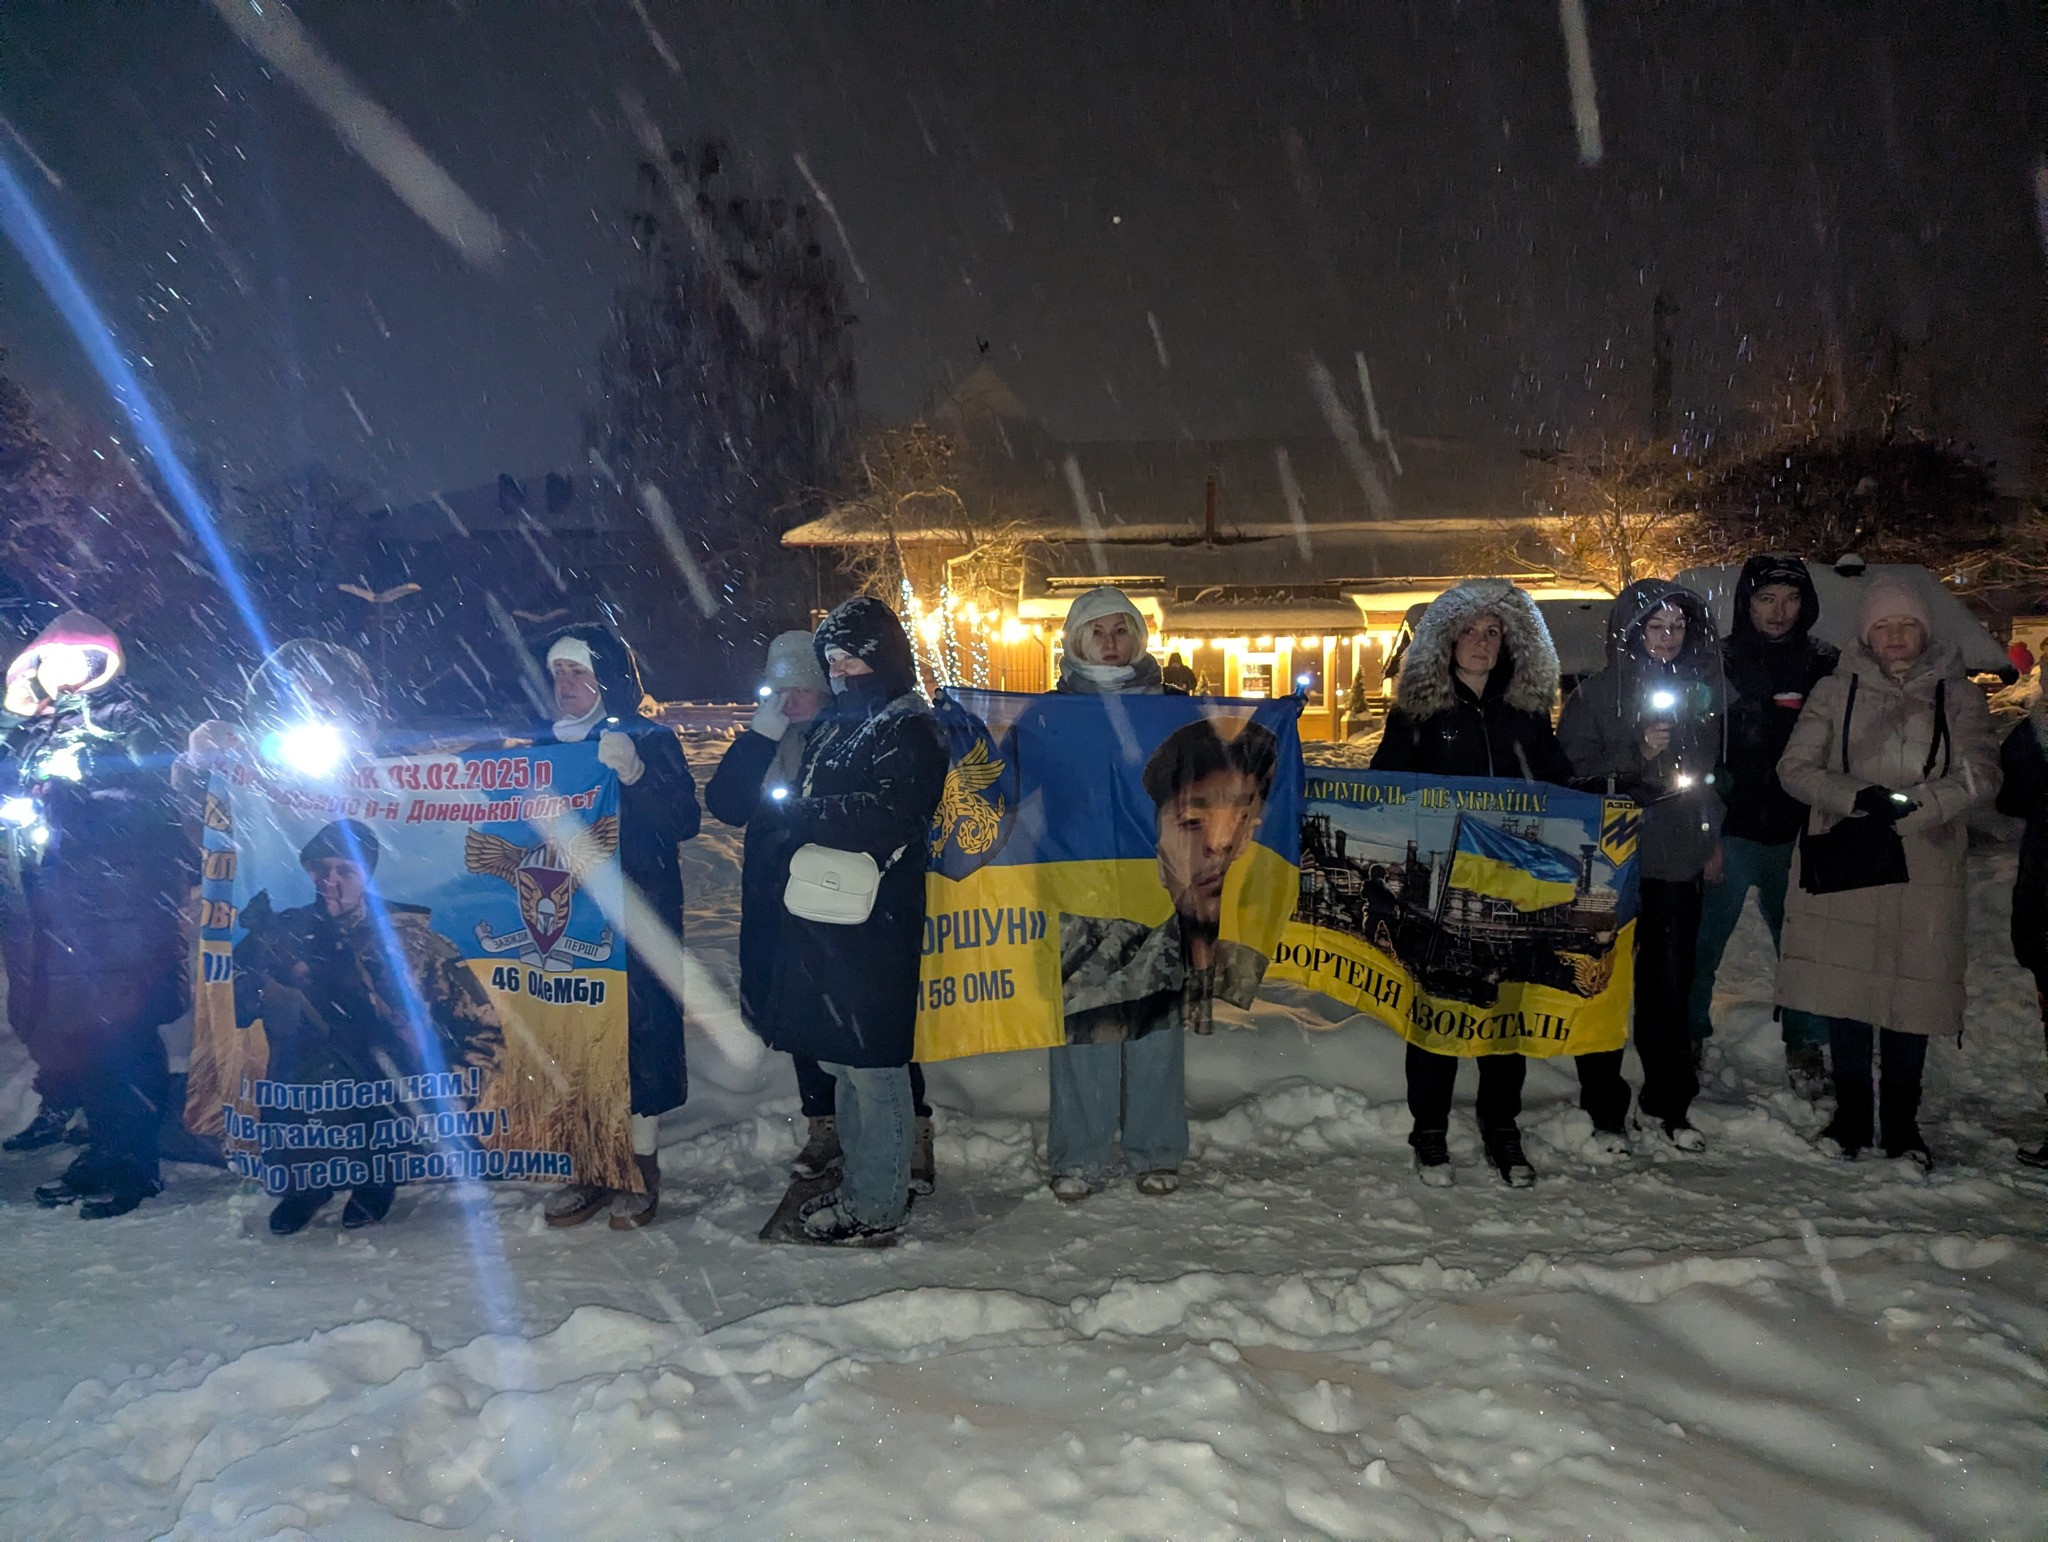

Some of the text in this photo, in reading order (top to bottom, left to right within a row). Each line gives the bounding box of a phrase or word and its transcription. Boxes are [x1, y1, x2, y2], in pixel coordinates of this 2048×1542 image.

[388, 757, 530, 790] 03.02.2025
[534, 760, 552, 791] р
[404, 796, 519, 824] Донецької
[1421, 788, 1450, 813] ЦЕ
[1456, 789, 1547, 812] УКРАЇНА!
[491, 930, 600, 957] ЗАВЖДИ ПЕРШІ
[921, 907, 1046, 956] ОРШУН»
[491, 965, 520, 992] 46
[917, 969, 1015, 1011] 158 ОМБ
[1405, 995, 1570, 1041] АЗОВСТАЛЬ
[254, 1079, 396, 1114] потрібен
[400, 1072, 465, 1102] нам
[370, 1110, 496, 1150] додому
[291, 1156, 369, 1191] тебе
[388, 1150, 465, 1183] Твоя
[469, 1149, 573, 1180] родина
